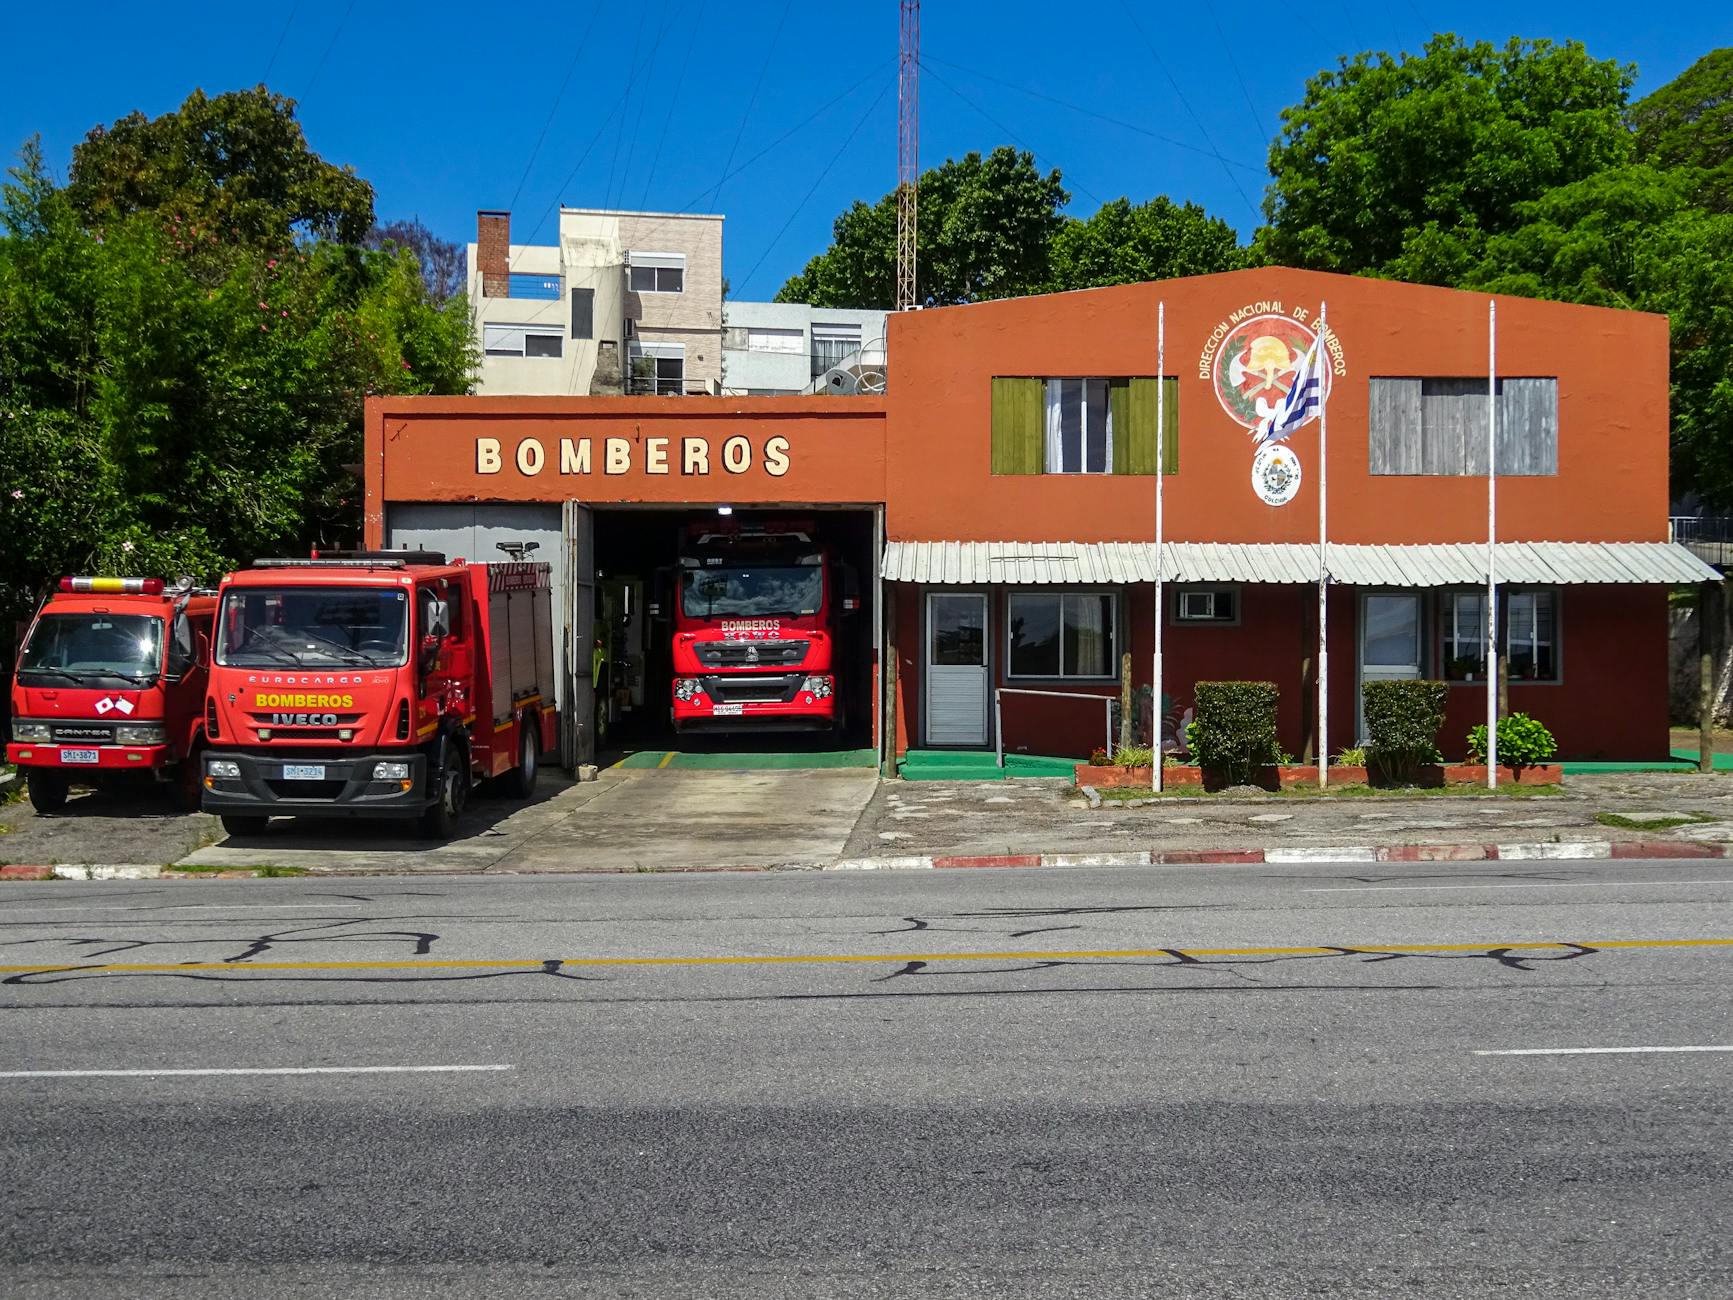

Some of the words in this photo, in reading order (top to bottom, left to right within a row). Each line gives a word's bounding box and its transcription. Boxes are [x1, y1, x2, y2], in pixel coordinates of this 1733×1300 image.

[1199, 322, 1230, 380] DIRECCIÓN
[1229, 301, 1285, 325] NACIONAL
[1292, 306, 1309, 322] DE
[475, 435, 791, 477] BOMBEROS
[721, 619, 780, 632] BOMBEROS
[248, 676, 363, 685] EUROCARGO
[256, 693, 354, 708] BOMBEROS
[272, 713, 338, 726] IVECO
[55, 728, 112, 737] CANTER
